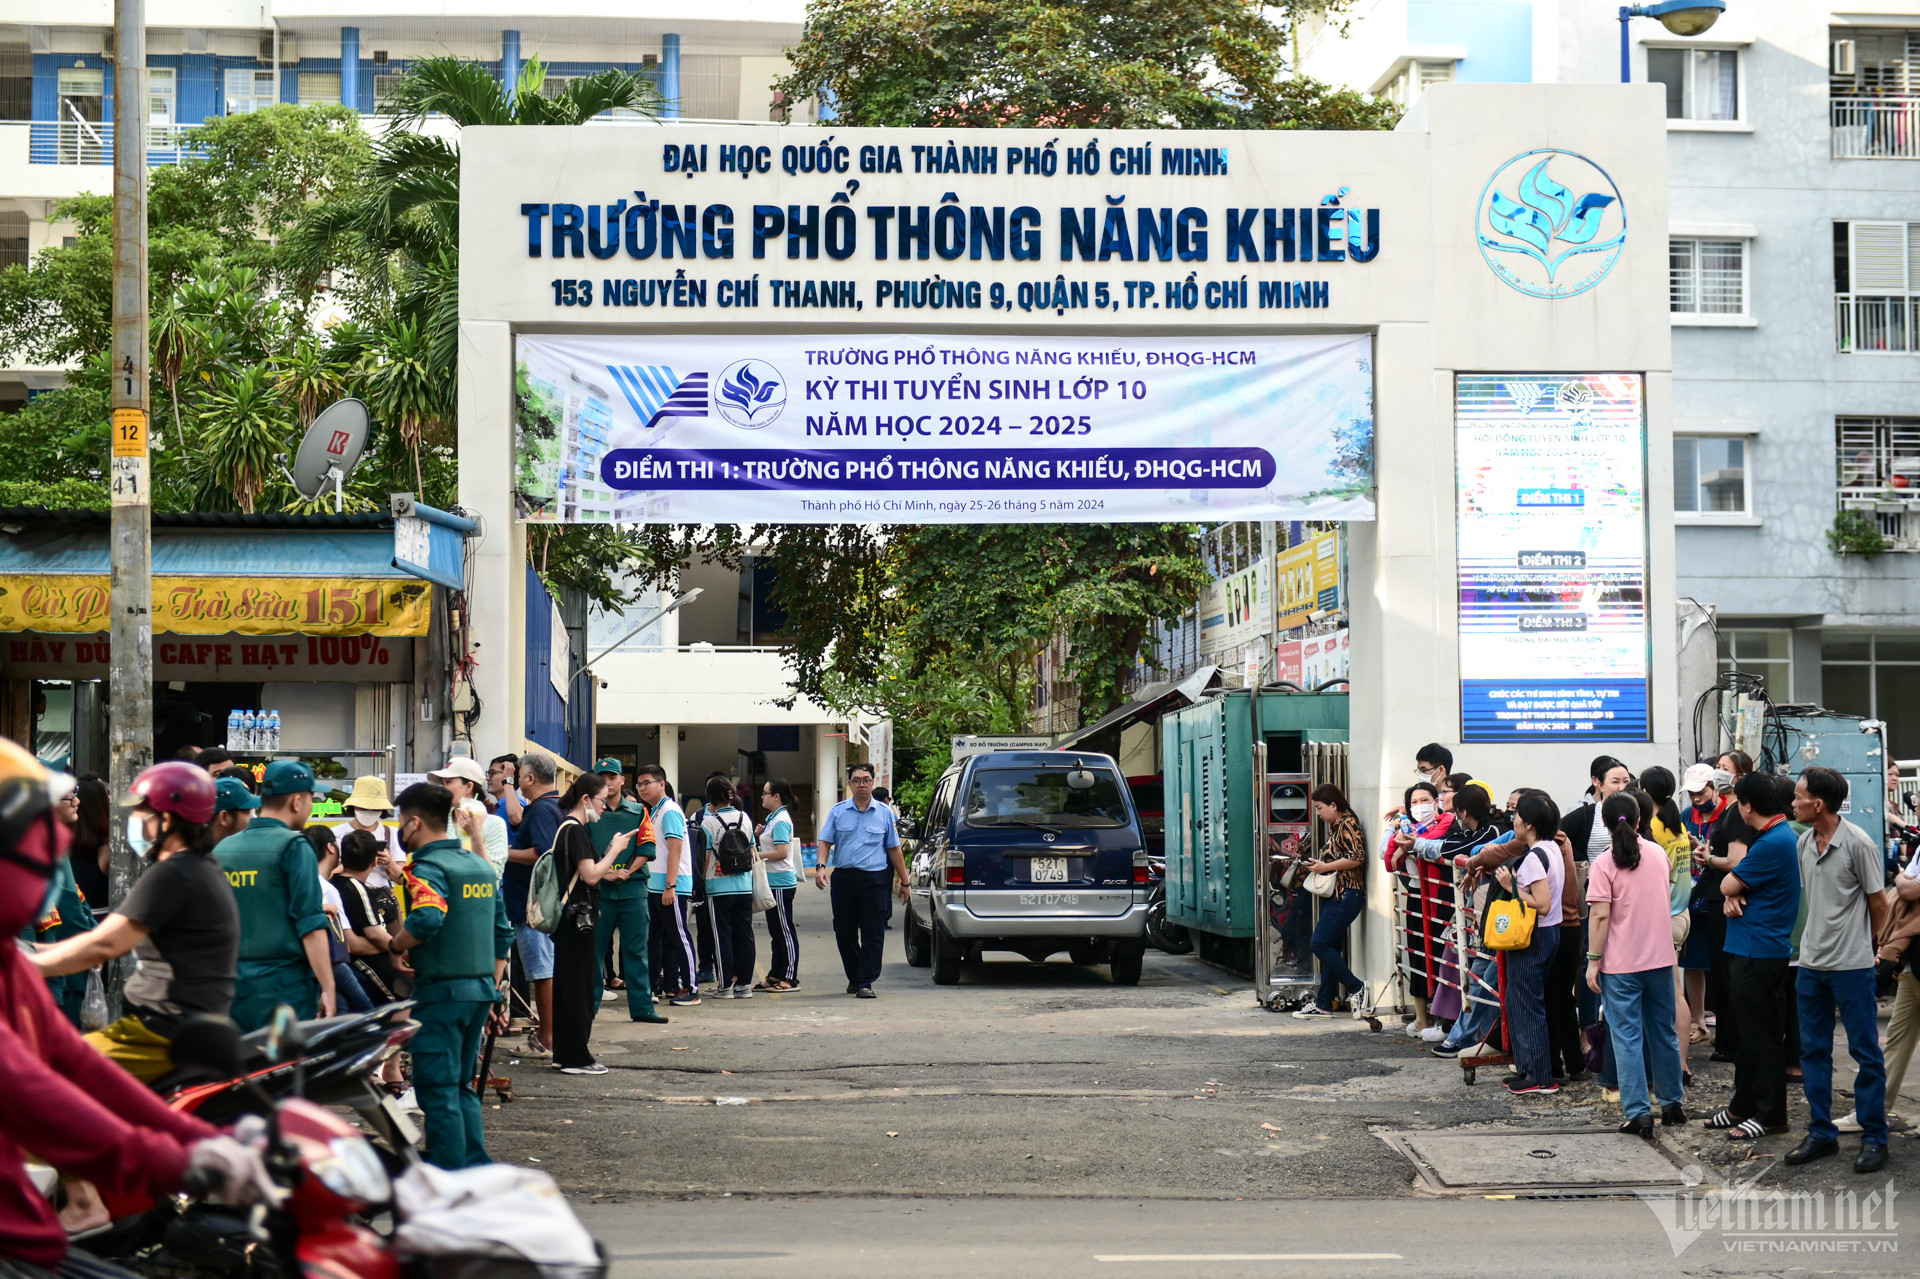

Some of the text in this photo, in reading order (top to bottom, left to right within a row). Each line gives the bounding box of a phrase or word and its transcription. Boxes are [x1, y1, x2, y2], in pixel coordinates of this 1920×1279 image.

[663, 136, 1227, 179] ĐẠI HỌC QUỐC GIA THÀNH PHỐ HỒ CHÍ MINH
[521, 179, 1379, 263] TRƯỜNG PHỔ THÔNG NĂNG KHIẾU
[552, 269, 1328, 316] 153 NGUYỄN CHÍ THANH, PHƯỜNG 9, QUẬN 5, TP. HỒ CHÍ MINH
[805, 345, 1256, 367] TRƯỜNG PHỔ THÔNG NĂNG KHIẾU, ĐHQG-HCM
[807, 373, 1146, 400] KỲ THI TUYỂN SINH LỚP 10
[120, 425, 138, 440] 12
[807, 412, 867, 435] NĂM
[876, 416, 931, 441] HỌC
[939, 416, 1002, 435] 2024
[1030, 416, 1091, 435] 2025
[614, 455, 1261, 480] ĐIỂM THI 1: TRƯỜNG PHỔ THÔNG NĂNG KHIẾU, ĐHQG-HCM
[801, 500, 1104, 512] Thành phố Hồ Chí Minh, ngày 25-26 tháng 5 năm 2024
[21, 584, 67, 618] Cà
[167, 586, 232, 620] Trà
[234, 587, 298, 621] Sữa
[300, 587, 389, 627] 151
[10, 636, 389, 671] HÃY DÙ CAFE HẠT 100%
[1035, 870, 1064, 880] 0749
[1038, 858, 1059, 869] 52T
